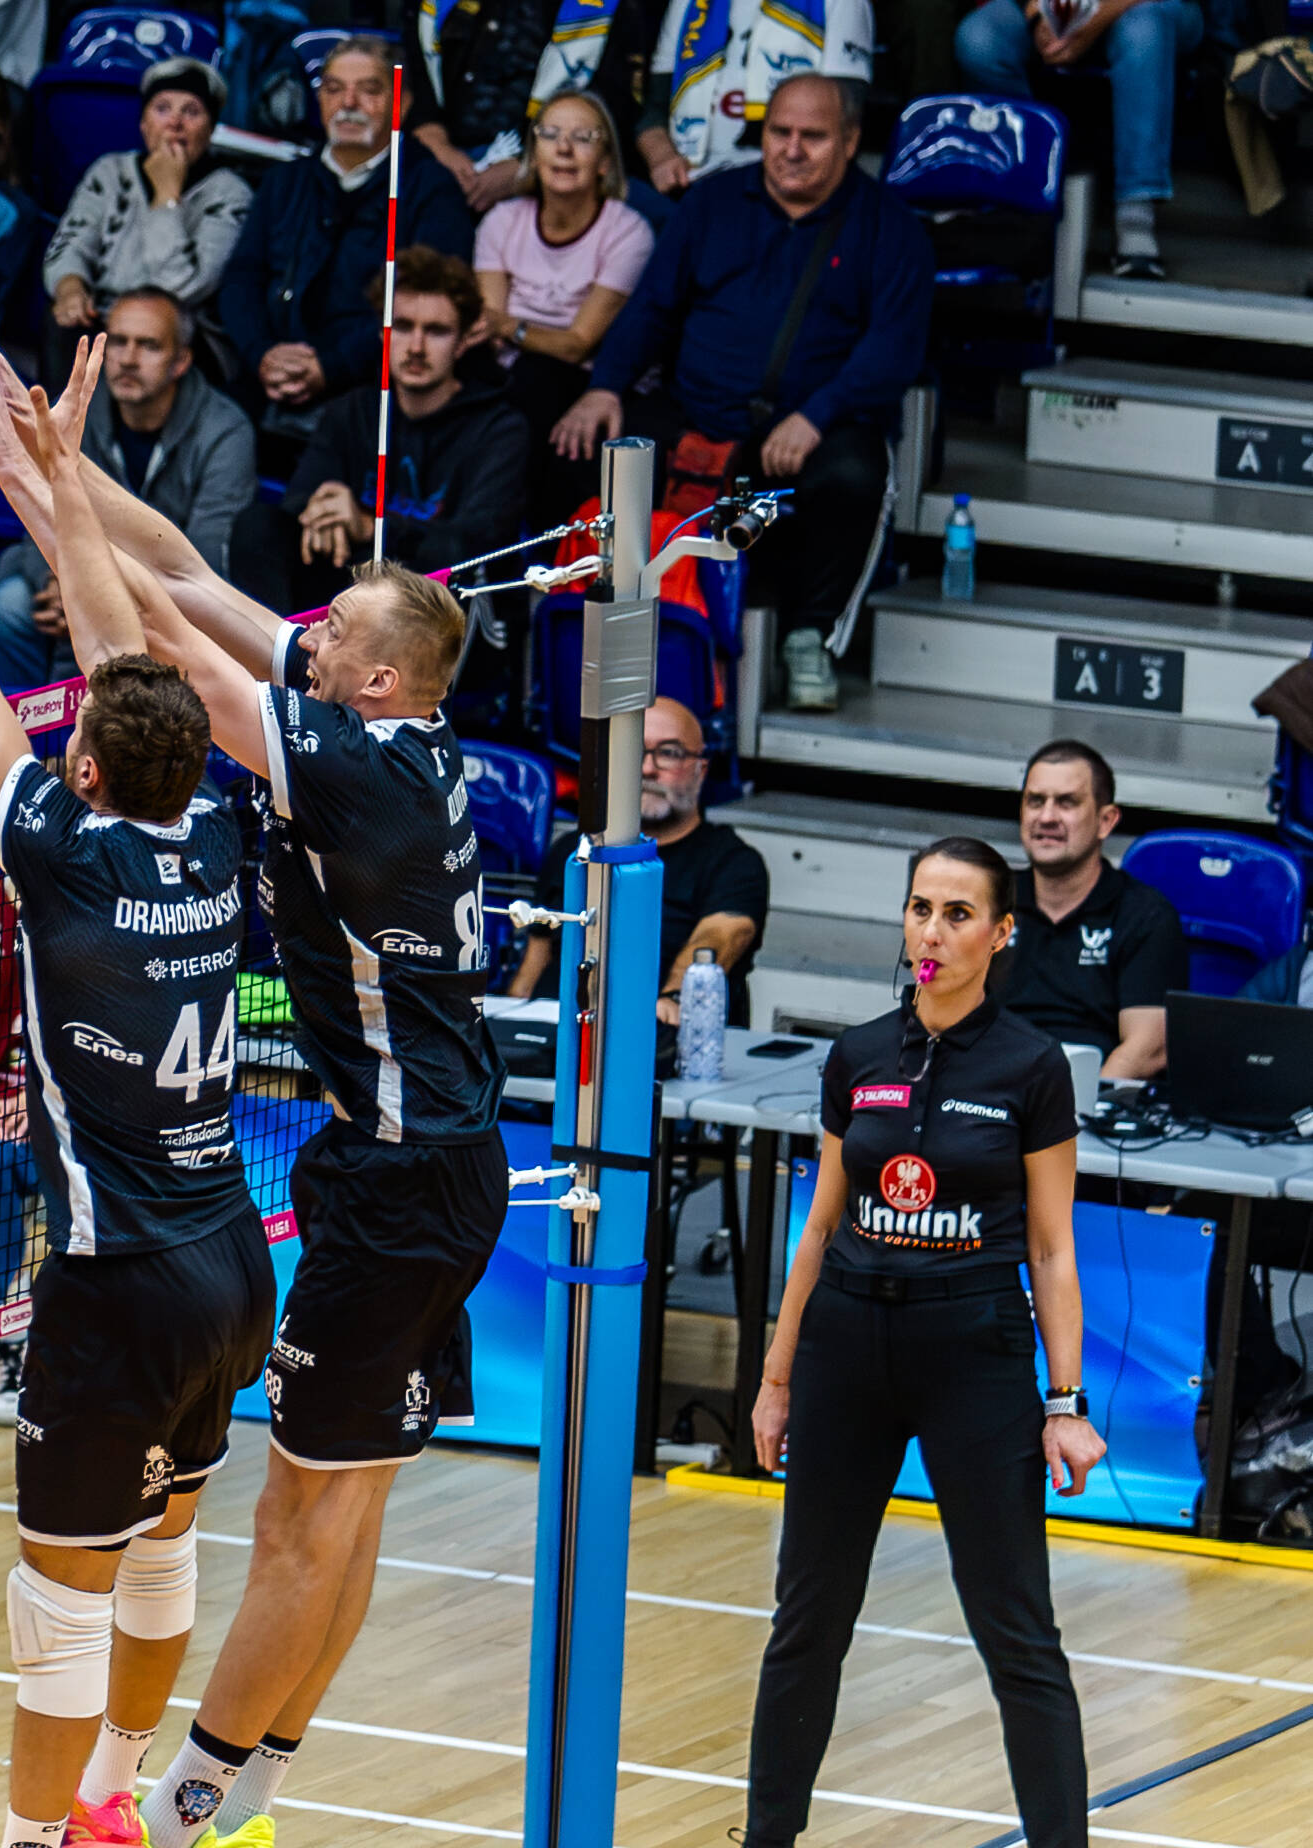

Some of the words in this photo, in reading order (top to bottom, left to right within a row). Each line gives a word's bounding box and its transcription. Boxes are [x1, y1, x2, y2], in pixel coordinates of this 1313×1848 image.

[1074, 662, 1098, 695] A
[1143, 668, 1161, 700] 3
[382, 937, 442, 958] Enea
[73, 1030, 144, 1066] Enea
[156, 988, 235, 1104] 44
[865, 1090, 903, 1102] TAURON
[955, 1101, 1008, 1120] DECATHLON
[265, 1368, 283, 1405] 88
